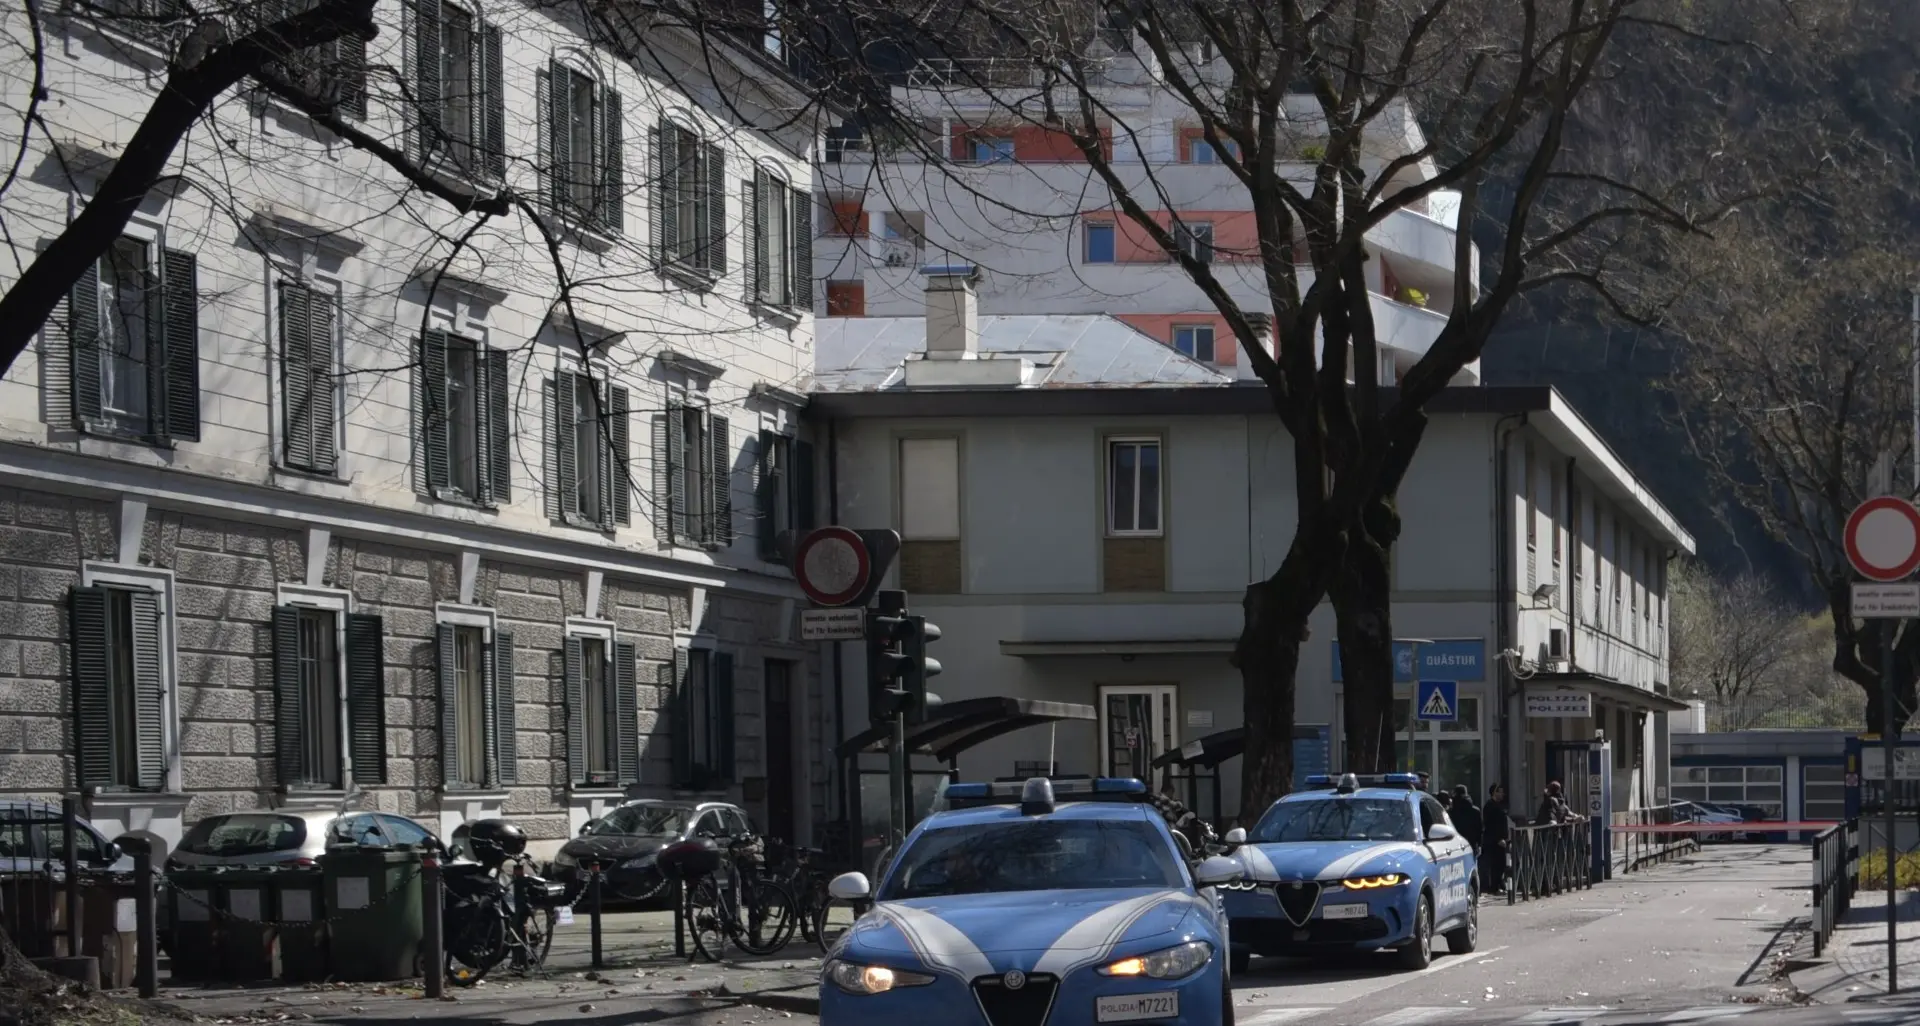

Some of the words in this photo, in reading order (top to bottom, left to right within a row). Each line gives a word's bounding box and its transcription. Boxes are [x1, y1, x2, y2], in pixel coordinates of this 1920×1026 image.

[1426, 653, 1476, 666] QUÄSTUR
[1528, 705, 1588, 713] POLIZEI
[1100, 1003, 1136, 1013] POLIZIA
[1138, 997, 1174, 1014] M7221
